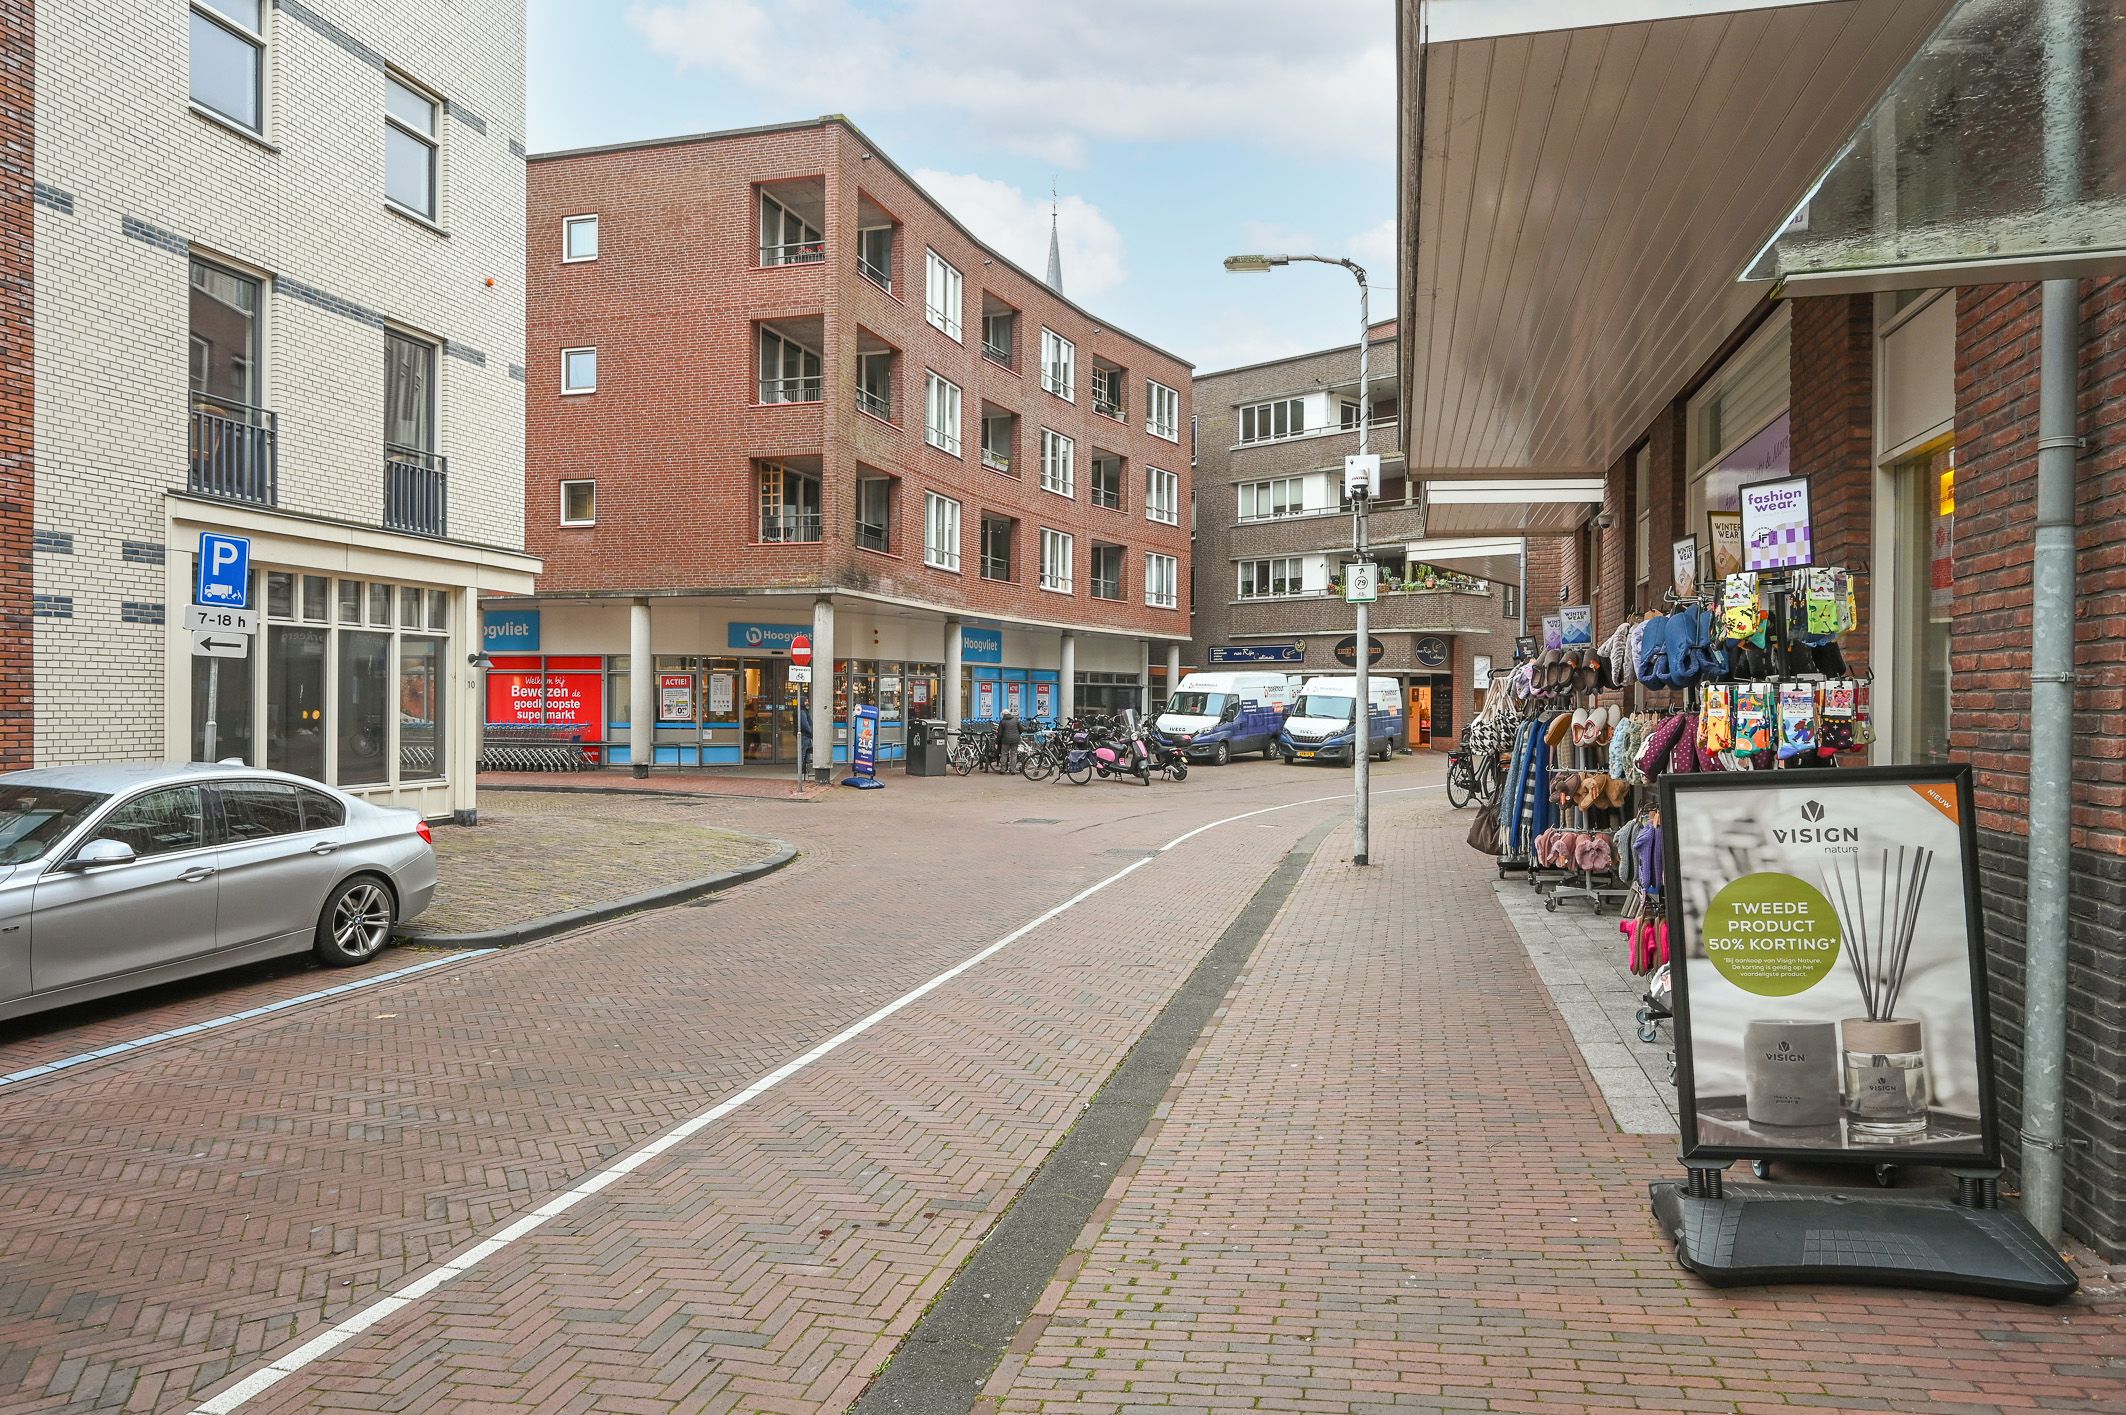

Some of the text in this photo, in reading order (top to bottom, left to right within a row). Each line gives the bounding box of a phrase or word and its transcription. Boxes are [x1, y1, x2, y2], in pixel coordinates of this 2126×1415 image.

[1748, 489, 1801, 505] fashion
[1754, 499, 1797, 513] wear.
[1714, 522, 1741, 531] WINTER
[1718, 530, 1739, 539] WEAR
[1677, 544, 1693, 555] WINTER
[212, 540, 238, 576] P
[1680, 552, 1693, 561] WEAR
[198, 612, 246, 628] 7-18 h
[964, 637, 998, 652] Hoogvliet
[525, 676, 565, 687] Welkm bij
[665, 678, 687, 686] ACTIE!
[511, 685, 581, 698] Bewezen de
[1926, 788, 1952, 809] NIEUW
[1772, 827, 1859, 844] VISIGN
[1824, 846, 1859, 854] nature
[1731, 902, 1809, 914] TWEEDE
[1728, 920, 1815, 932] PRODUCT
[1708, 938, 1745, 951] 50%
[1765, 1053, 1806, 1062] VISIGN
